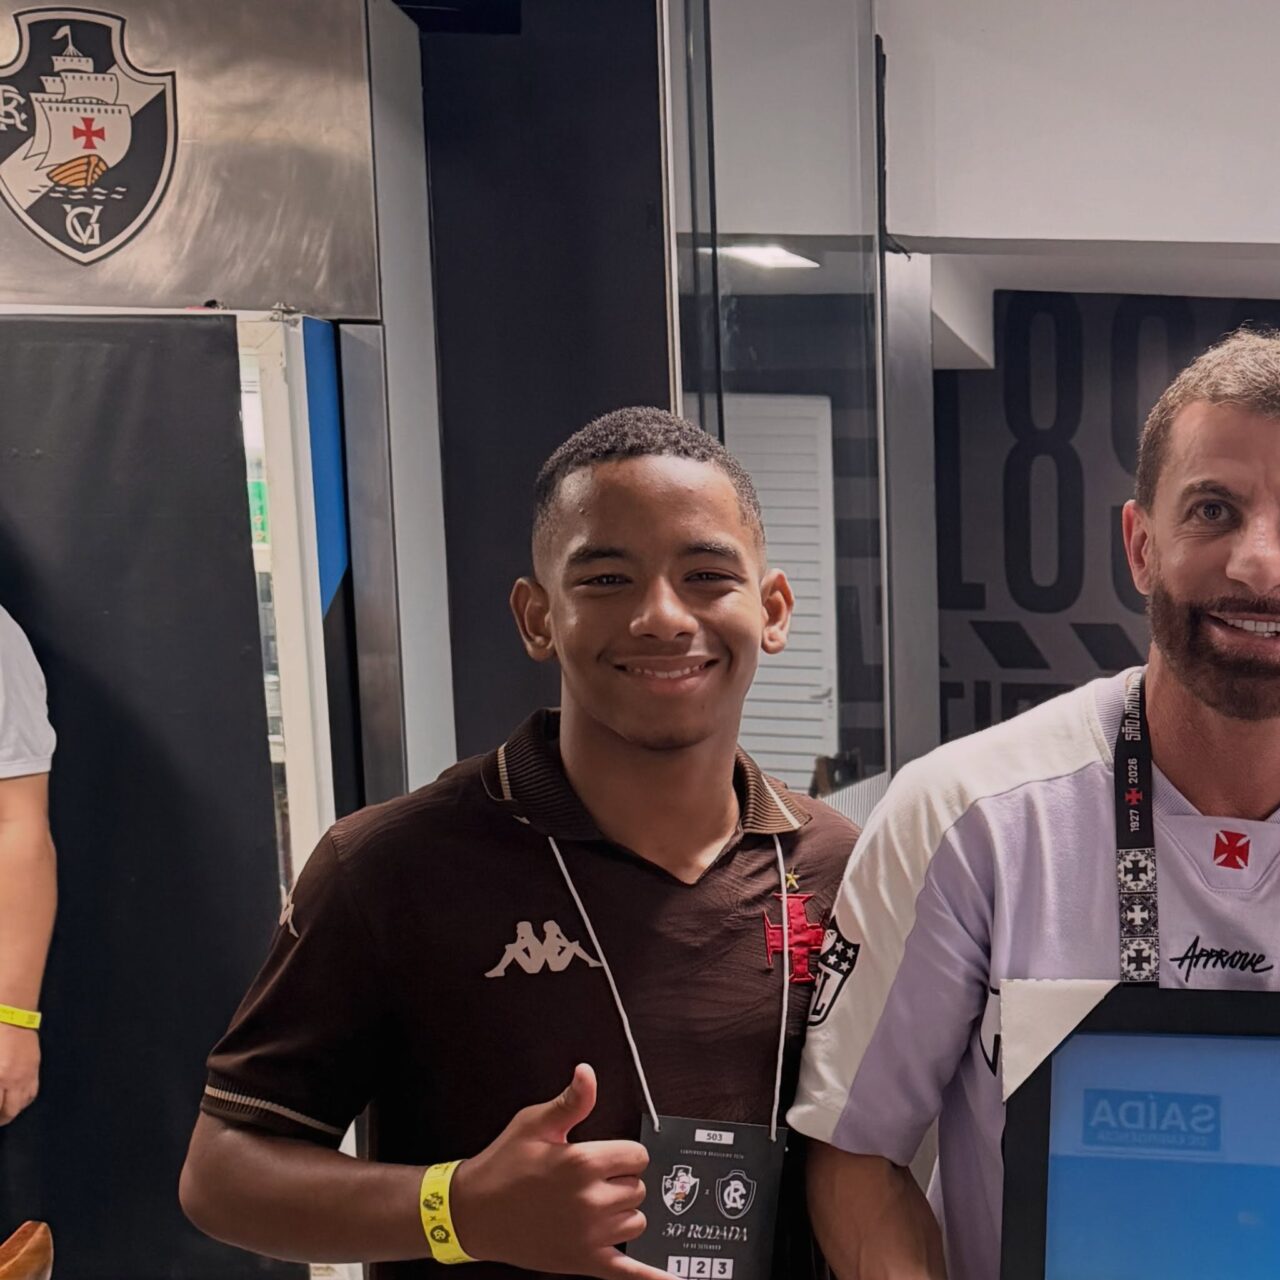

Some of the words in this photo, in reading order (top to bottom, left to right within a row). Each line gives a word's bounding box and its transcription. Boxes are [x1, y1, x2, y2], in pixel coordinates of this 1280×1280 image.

[1127, 757, 1139, 784] 2026
[1130, 809, 1140, 833] 1927
[706, 1132, 724, 1142] 503
[687, 1223, 748, 1241] RODADA
